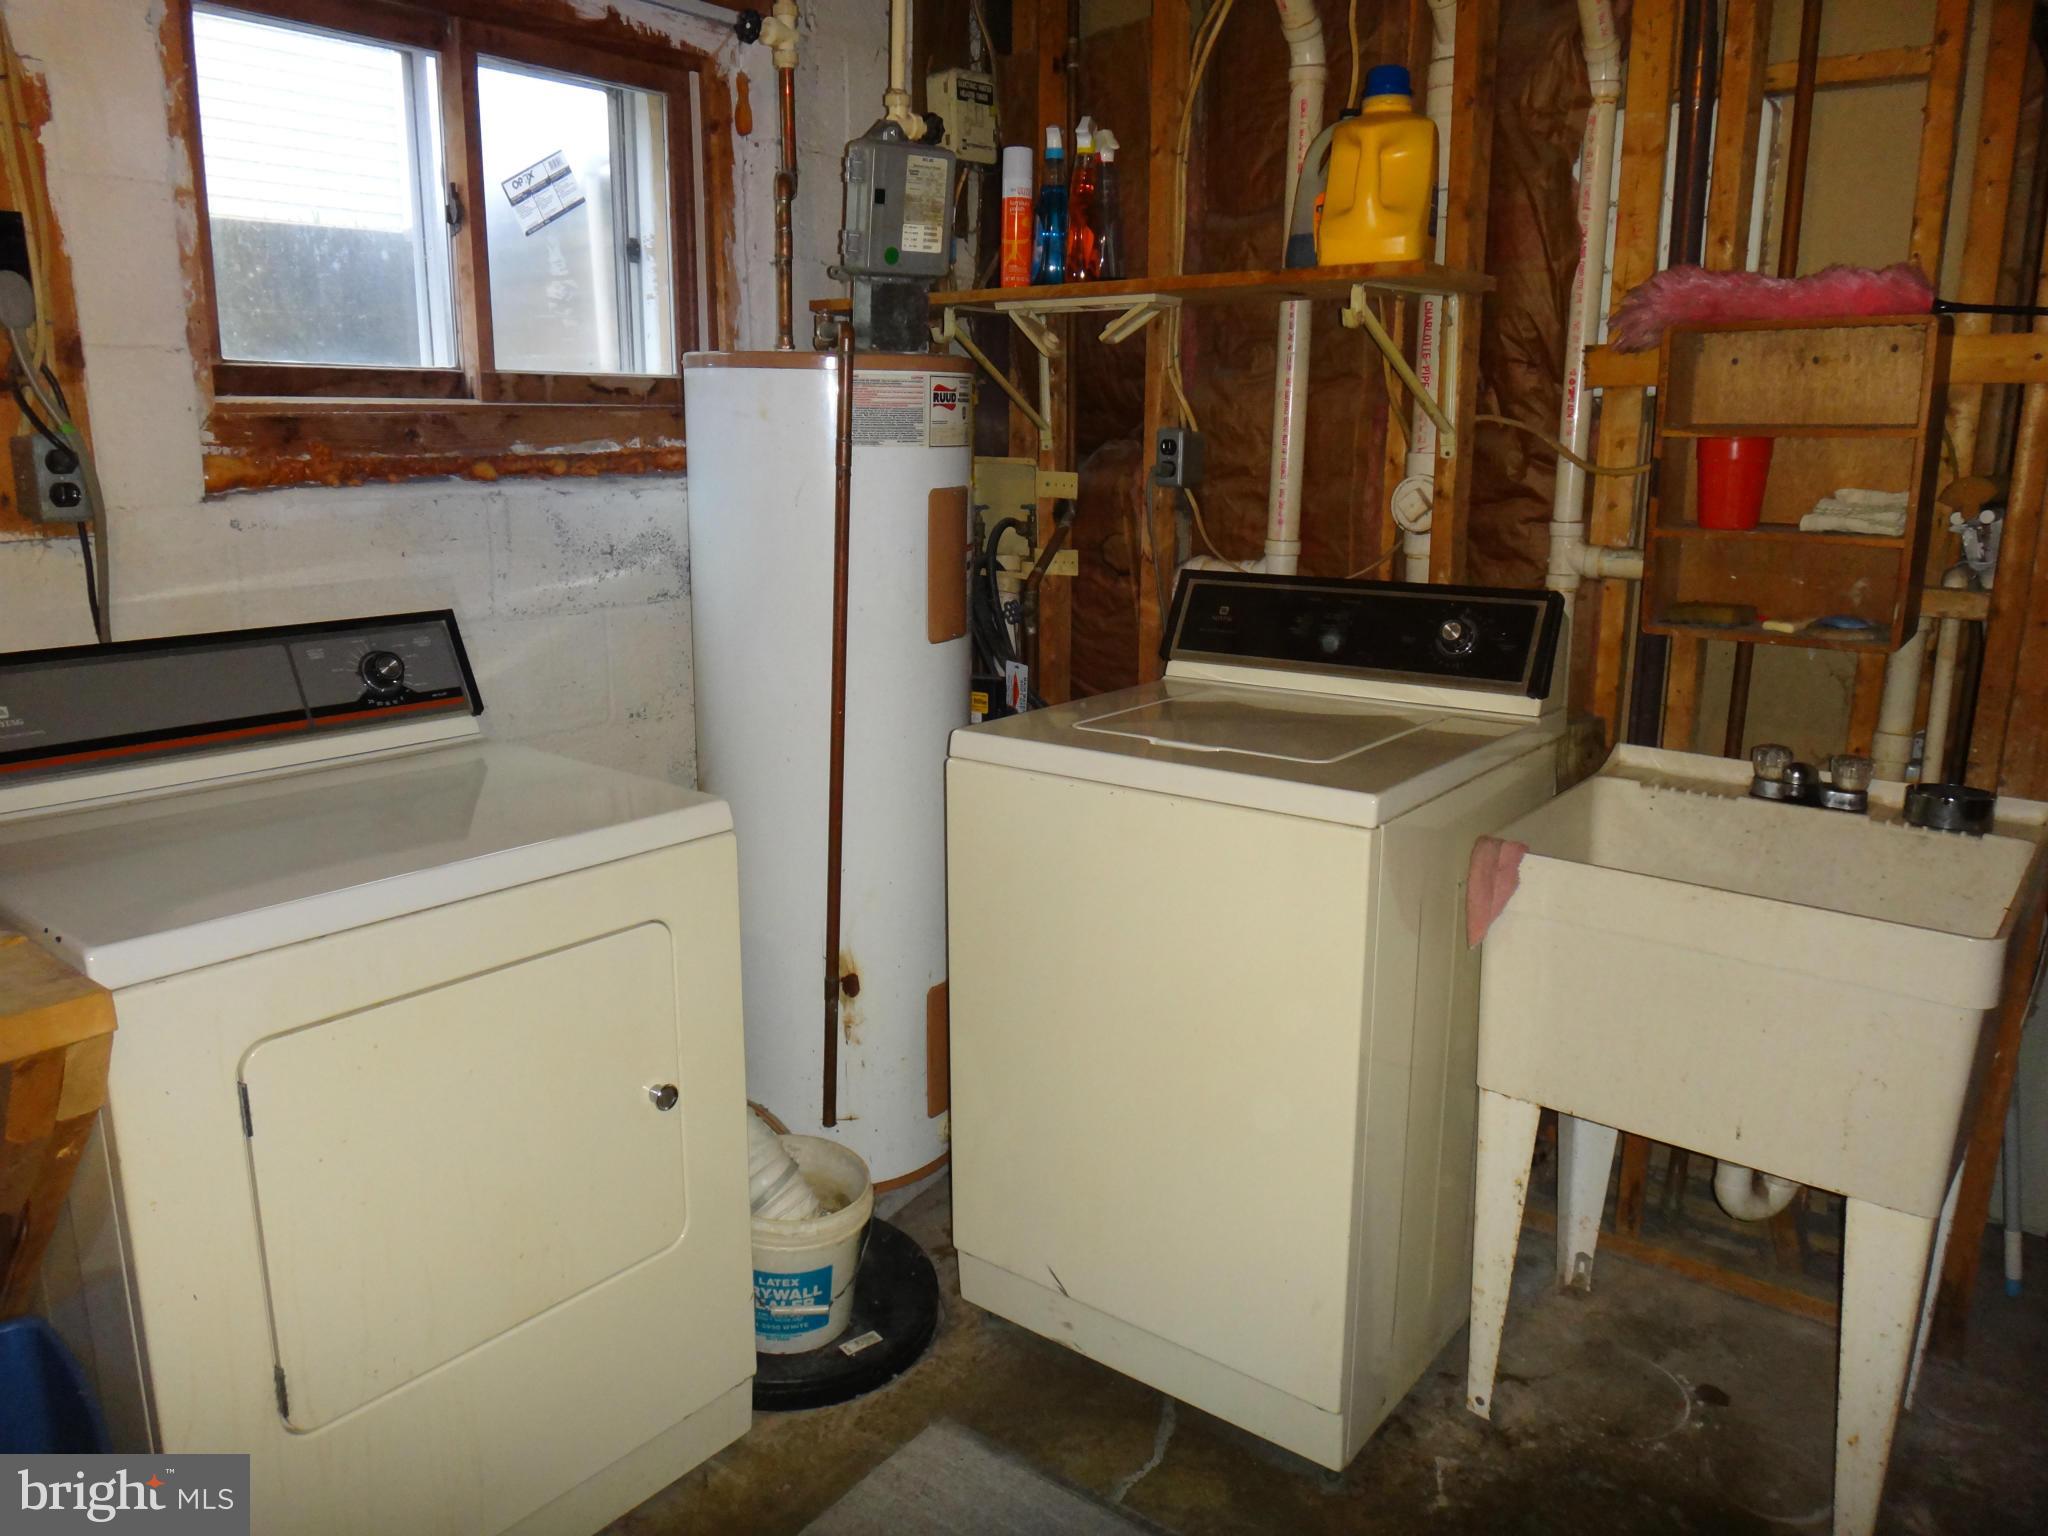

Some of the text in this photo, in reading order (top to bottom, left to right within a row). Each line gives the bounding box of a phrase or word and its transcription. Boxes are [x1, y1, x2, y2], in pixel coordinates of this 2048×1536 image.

[1421, 301, 1434, 360] CHARLOTTE
[933, 392, 957, 403] RUUD
[758, 1277, 801, 1287] LATEX
[754, 1285, 823, 1300] RYWALL
